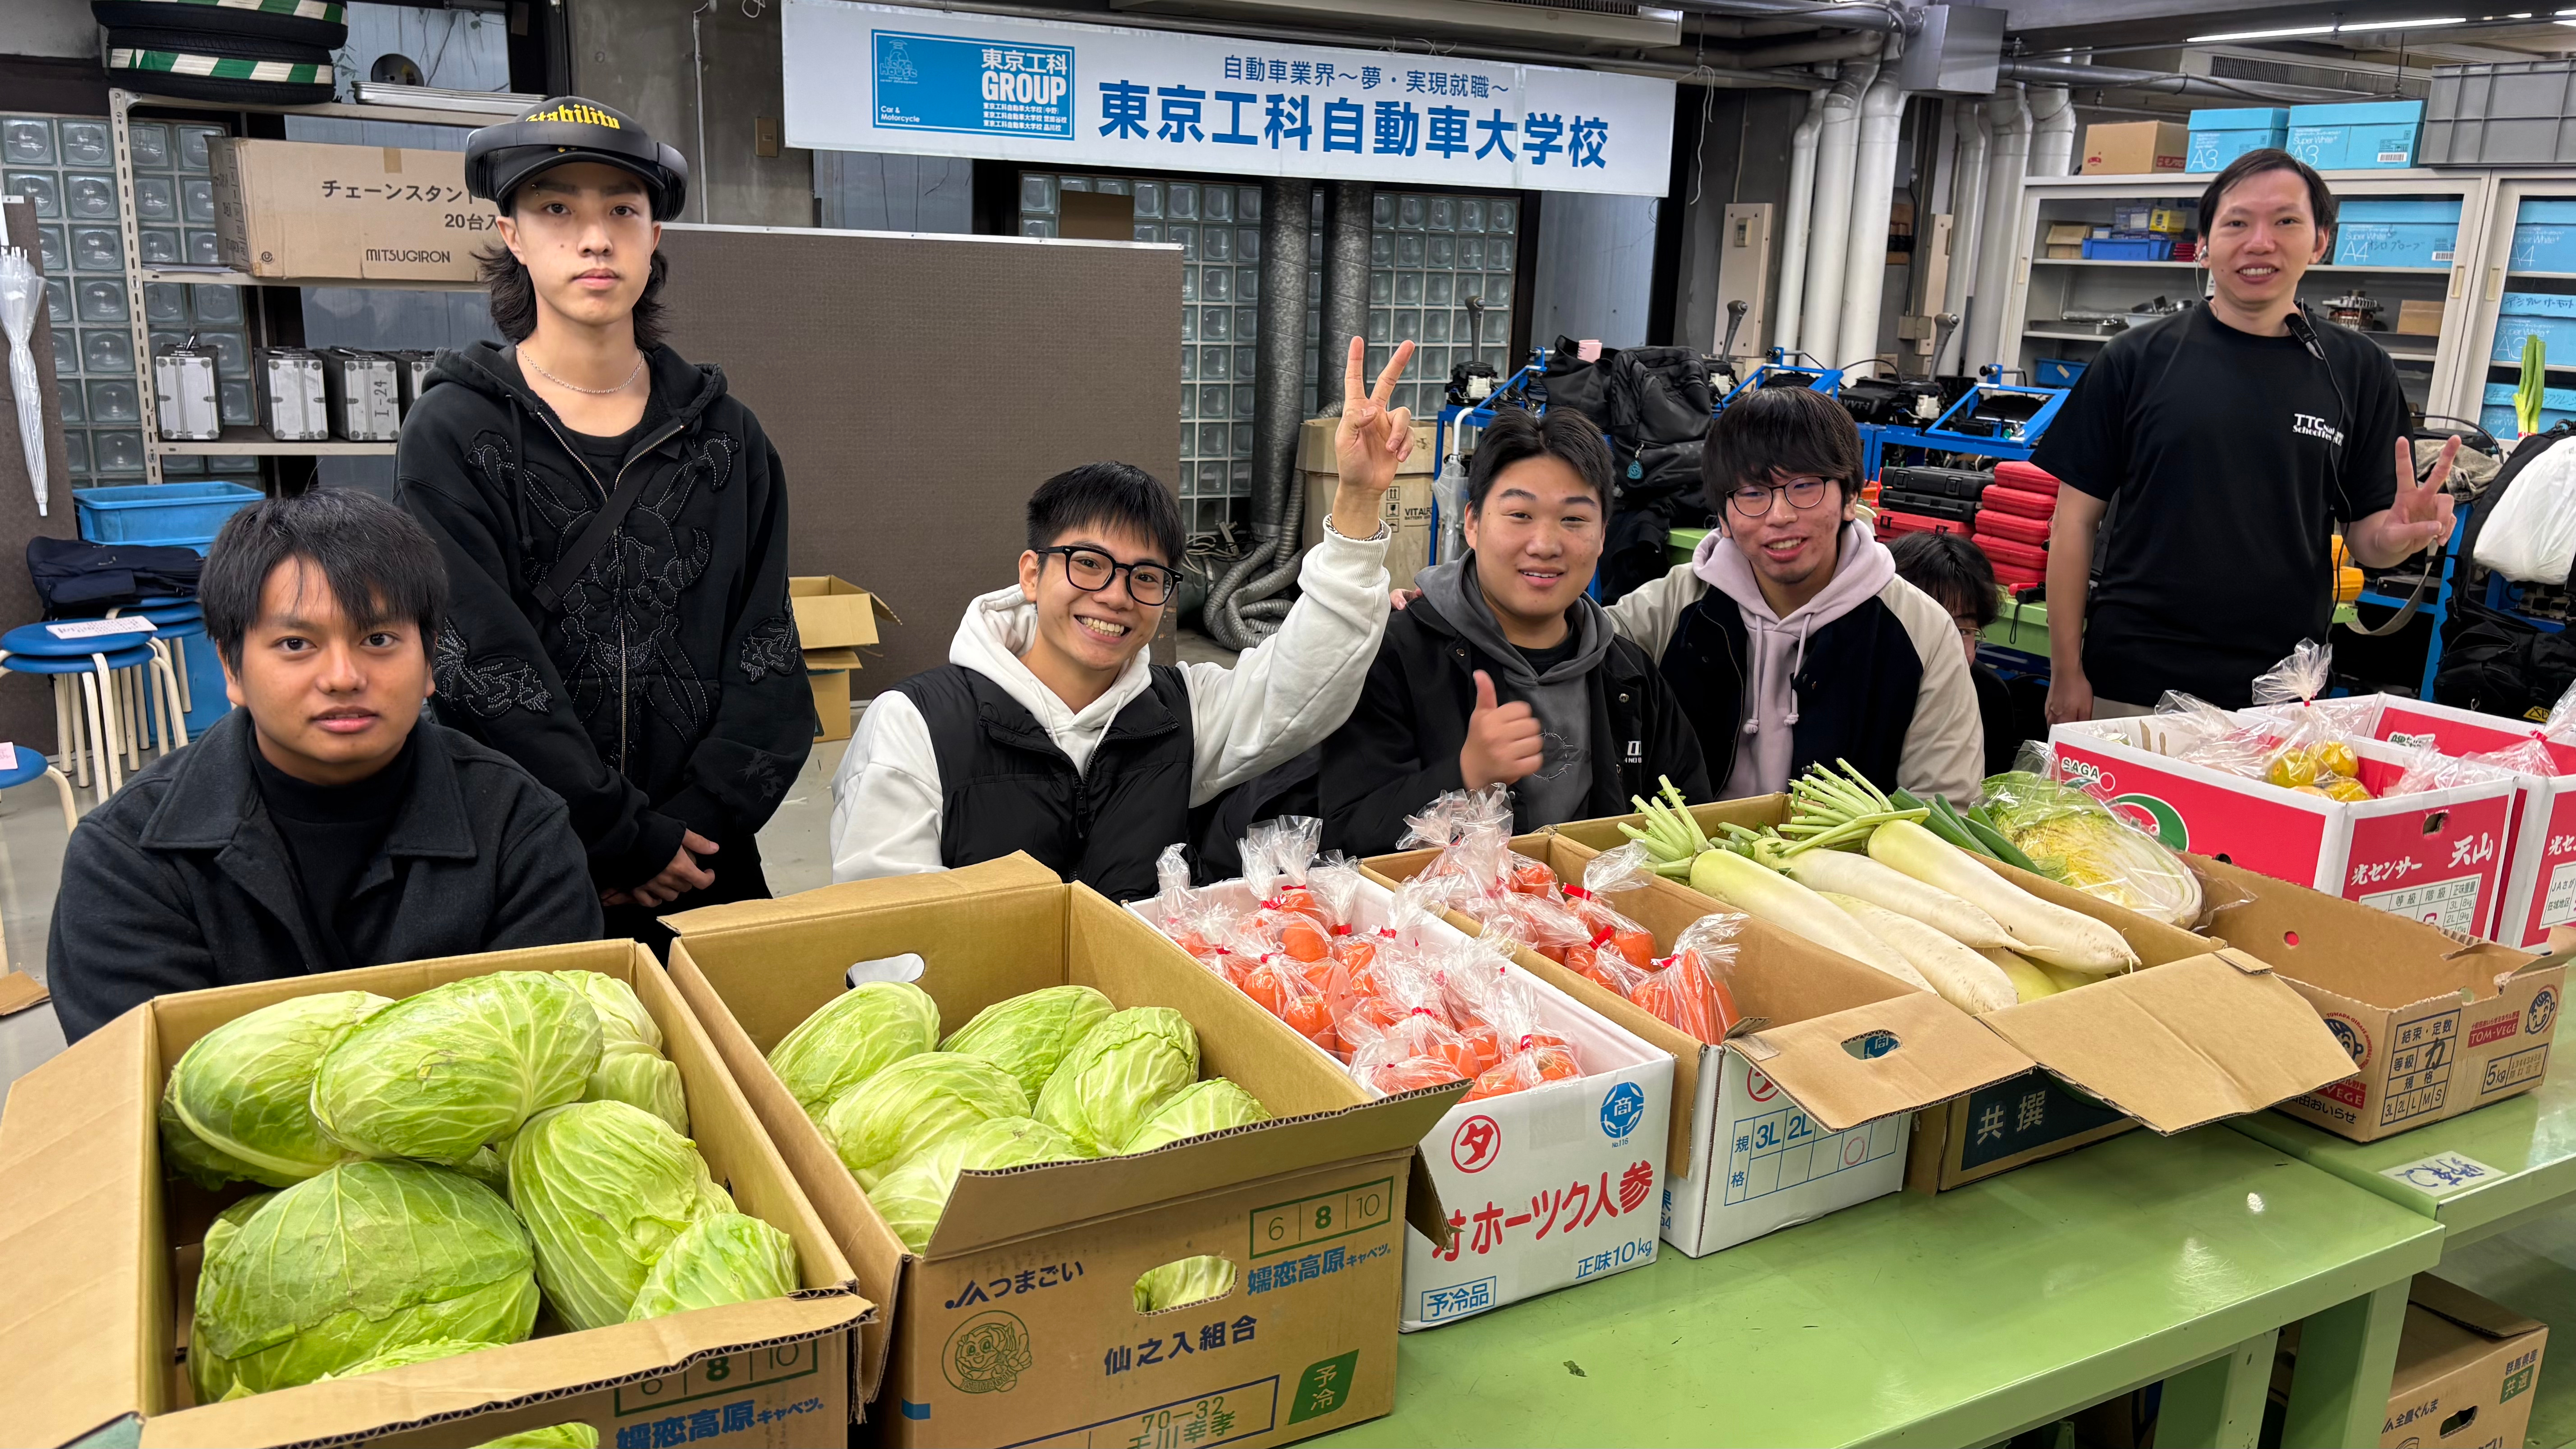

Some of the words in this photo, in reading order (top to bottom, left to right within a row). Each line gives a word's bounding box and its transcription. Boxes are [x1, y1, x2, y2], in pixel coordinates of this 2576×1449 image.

[981, 48, 1067, 75] 東京工科
[982, 71, 1067, 105] GROUP
[881, 114, 920, 123] Motorcycle
[1099, 79, 1608, 169] 東京工科自動車大学校
[2190, 149, 2218, 170] A3
[366, 248, 450, 263] MITSUGIRON
[2340, 240, 2369, 262] A4
[2294, 413, 2325, 431] TTC
[2063, 759, 2098, 779] SAGA
[2548, 835, 2576, 856] 光セ
[2351, 856, 2423, 886] 光センサー
[2447, 832, 2493, 869] 天山
[2449, 898, 2458, 910] 3L
[2446, 913, 2456, 923] 2L
[2470, 1023, 2517, 1044] TOM-VEGE
[2486, 1064, 2507, 1086] 5kg
[1614, 1096, 1632, 1117] 商
[2385, 1104, 2393, 1118] 3L
[2397, 1099, 2405, 1113] 2L
[2411, 1096, 2416, 1109] L
[2422, 1091, 2431, 1106] M
[2435, 1088, 2443, 1101] S
[1977, 1090, 2046, 1145] 共撰
[1755, 1121, 1781, 1149] 3L
[1787, 1115, 1813, 1141] 2L
[1269, 1216, 1284, 1241] 6
[1315, 1205, 1332, 1229] 8
[1356, 1193, 1380, 1219] 10
[1426, 1281, 1489, 1317] 予冷品
[1104, 1314, 1258, 1376] 仙之入組合
[1310, 1363, 1339, 1411] 予冷
